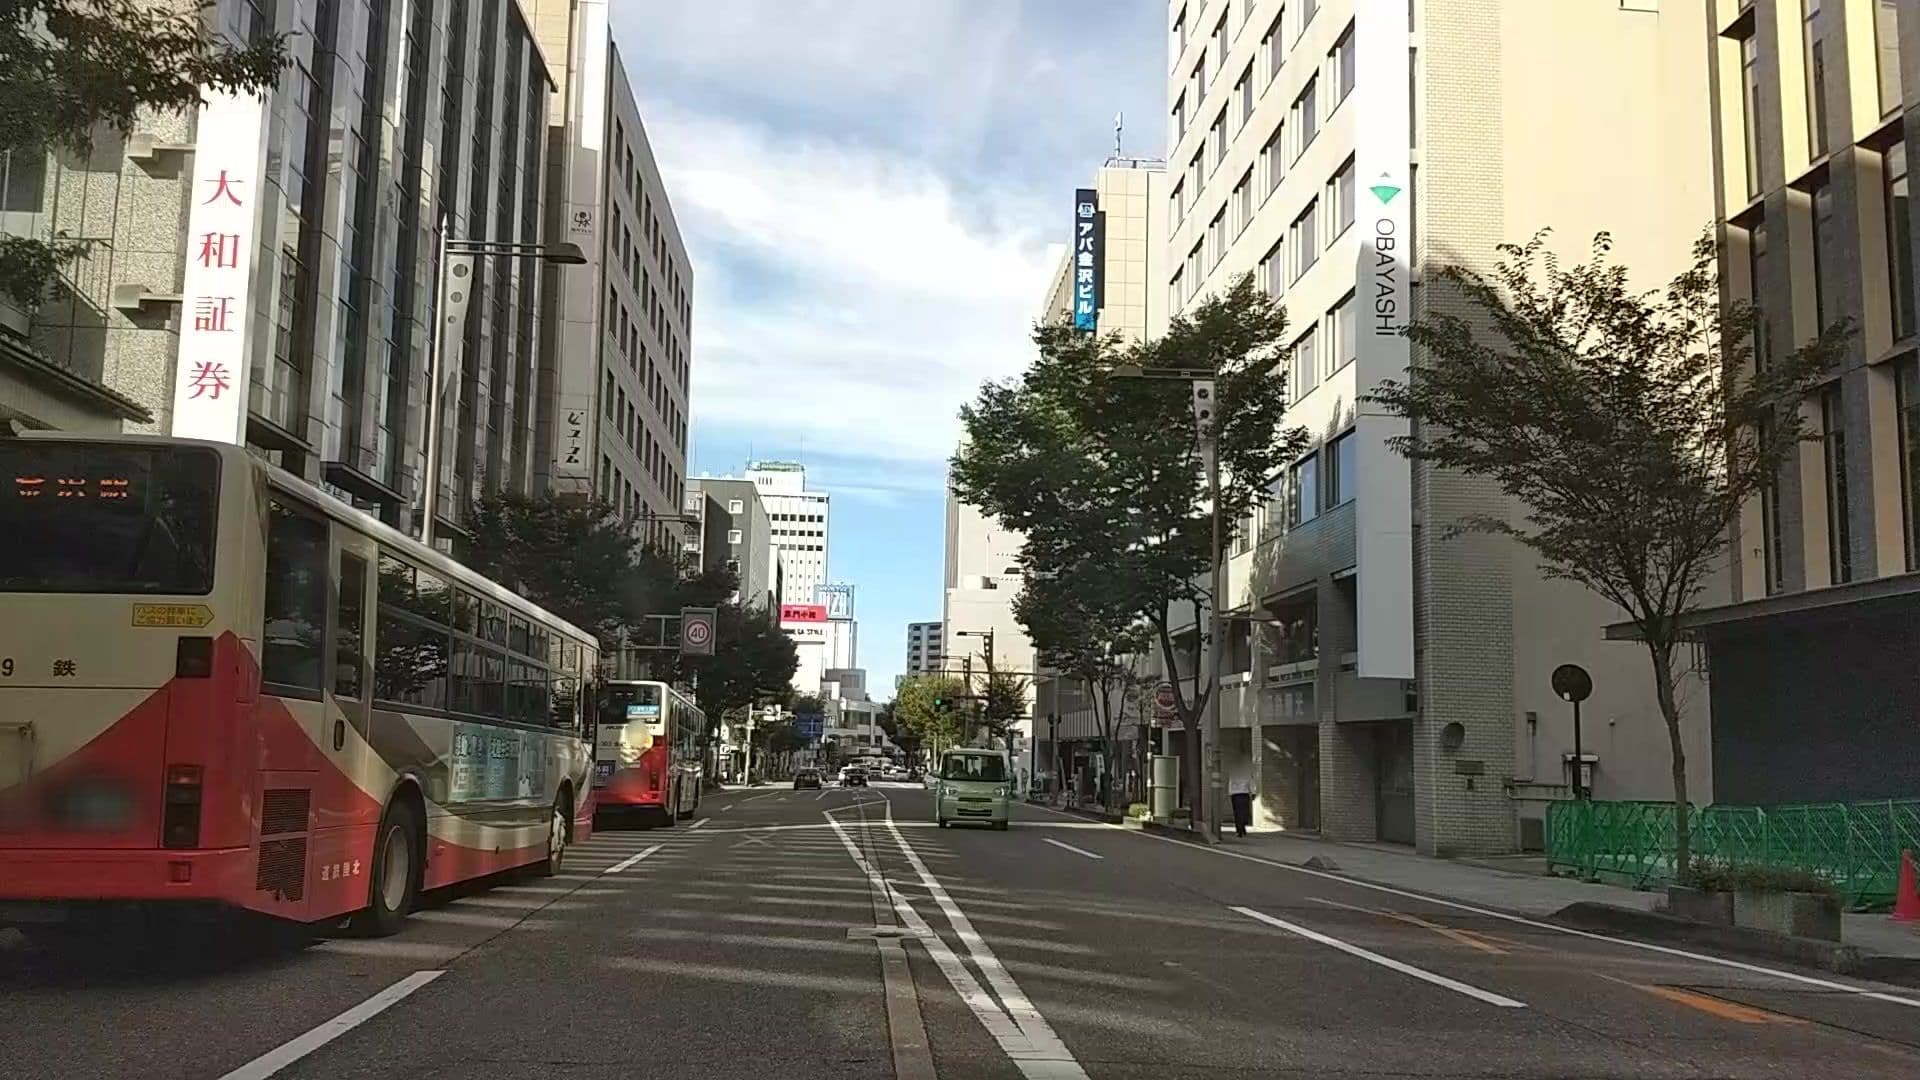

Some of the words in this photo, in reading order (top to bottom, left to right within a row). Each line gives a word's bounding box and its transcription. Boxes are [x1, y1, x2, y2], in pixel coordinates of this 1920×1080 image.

[188, 170, 244, 400] 大和証券
[1078, 222, 1094, 314] アパ金沢ビル
[1376, 218, 1395, 336] OBAYASHI
[53, 659, 76, 677] 鉄
[690, 627, 706, 639] 40
